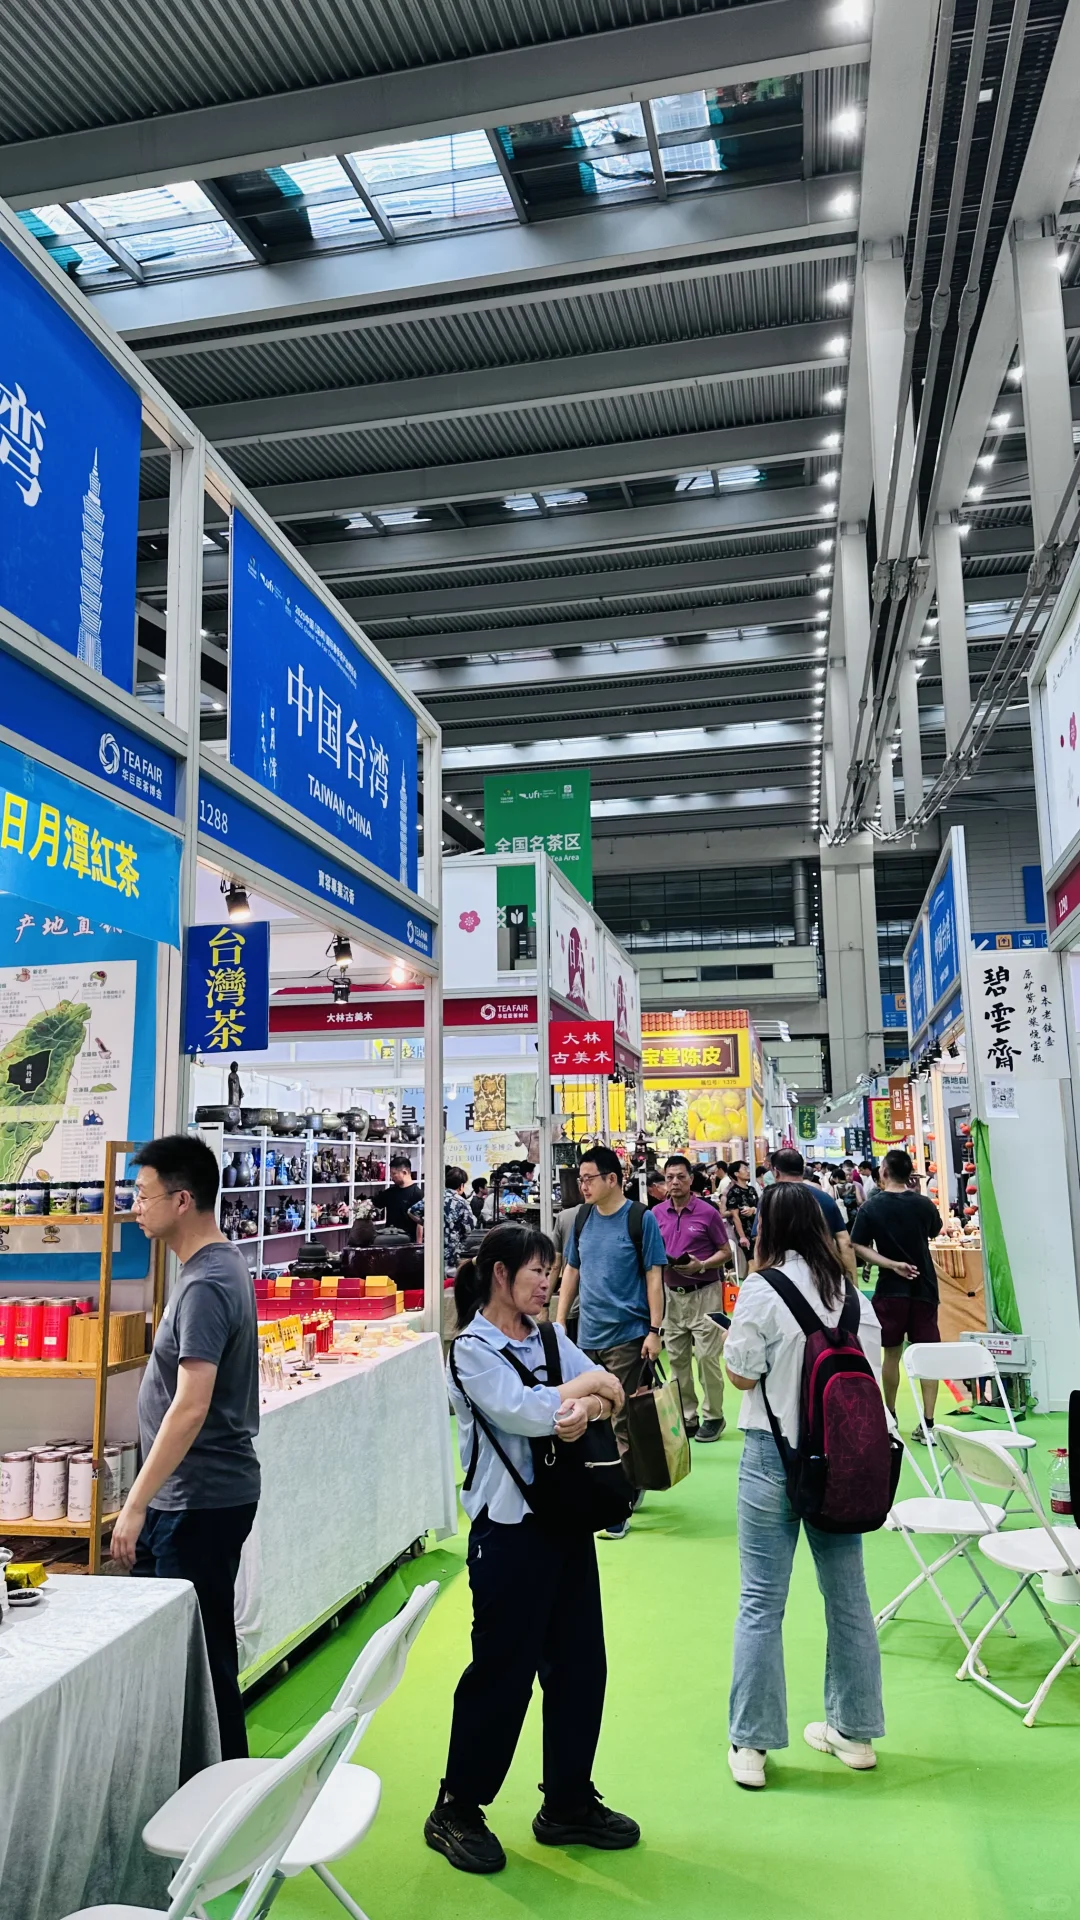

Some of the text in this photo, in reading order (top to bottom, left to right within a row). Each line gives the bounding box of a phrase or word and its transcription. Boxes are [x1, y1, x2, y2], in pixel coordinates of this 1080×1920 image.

[287, 663, 390, 809] 中国台湾
[122, 746, 163, 785] TEA FAIR
[122, 768, 162, 801] 华巨臣茶博会
[199, 799, 229, 835] 1288
[307, 773, 373, 841] TAIWAN CHINA
[1, 791, 140, 899] 日月潭紅茶
[495, 833, 581, 853] 全国名茶区
[551, 854, 580, 862] Tea Area
[204, 927, 247, 1050] 台灣茶
[497, 1004, 529, 1013] TEA FAIR
[562, 1031, 601, 1045] 大林
[551, 1051, 612, 1065] 古美术
[642, 1045, 722, 1067] 宝堂陈皮
[942, 1076, 969, 1085] 落地自
